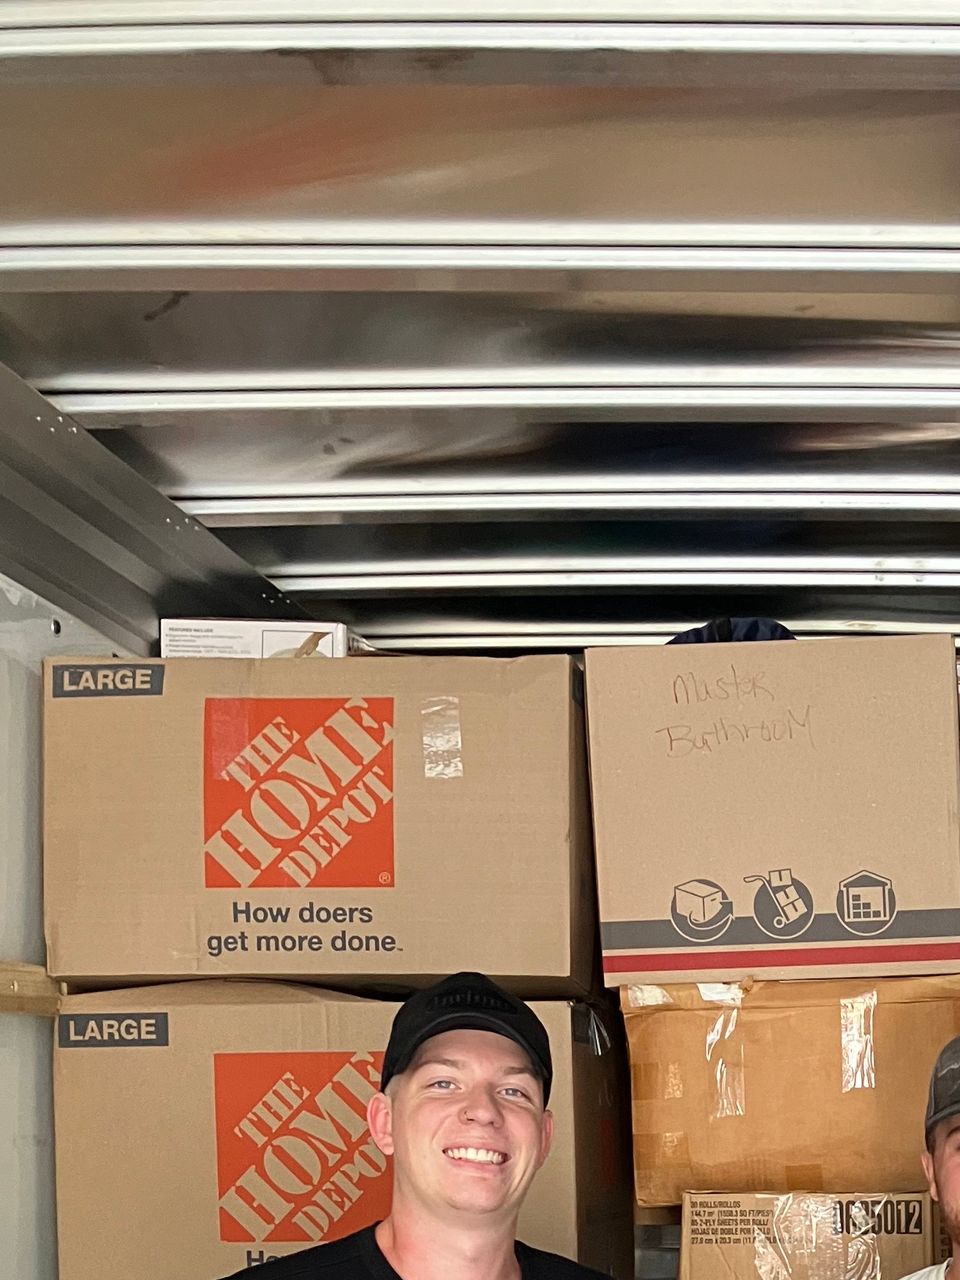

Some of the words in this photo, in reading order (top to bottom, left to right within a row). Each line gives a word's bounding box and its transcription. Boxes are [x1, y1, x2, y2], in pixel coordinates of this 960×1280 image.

[63, 669, 152, 691] LARGE
[220, 716, 301, 792] THE
[204, 697, 396, 888] HOME
[277, 766, 394, 888] DEPOT
[207, 932, 248, 957] get
[256, 935, 322, 952] more
[232, 902, 290, 924] How
[298, 902, 373, 924] doers
[68, 1019, 157, 1041] LARGE
[233, 1071, 311, 1149] THE
[292, 1138, 388, 1242] DEPO
